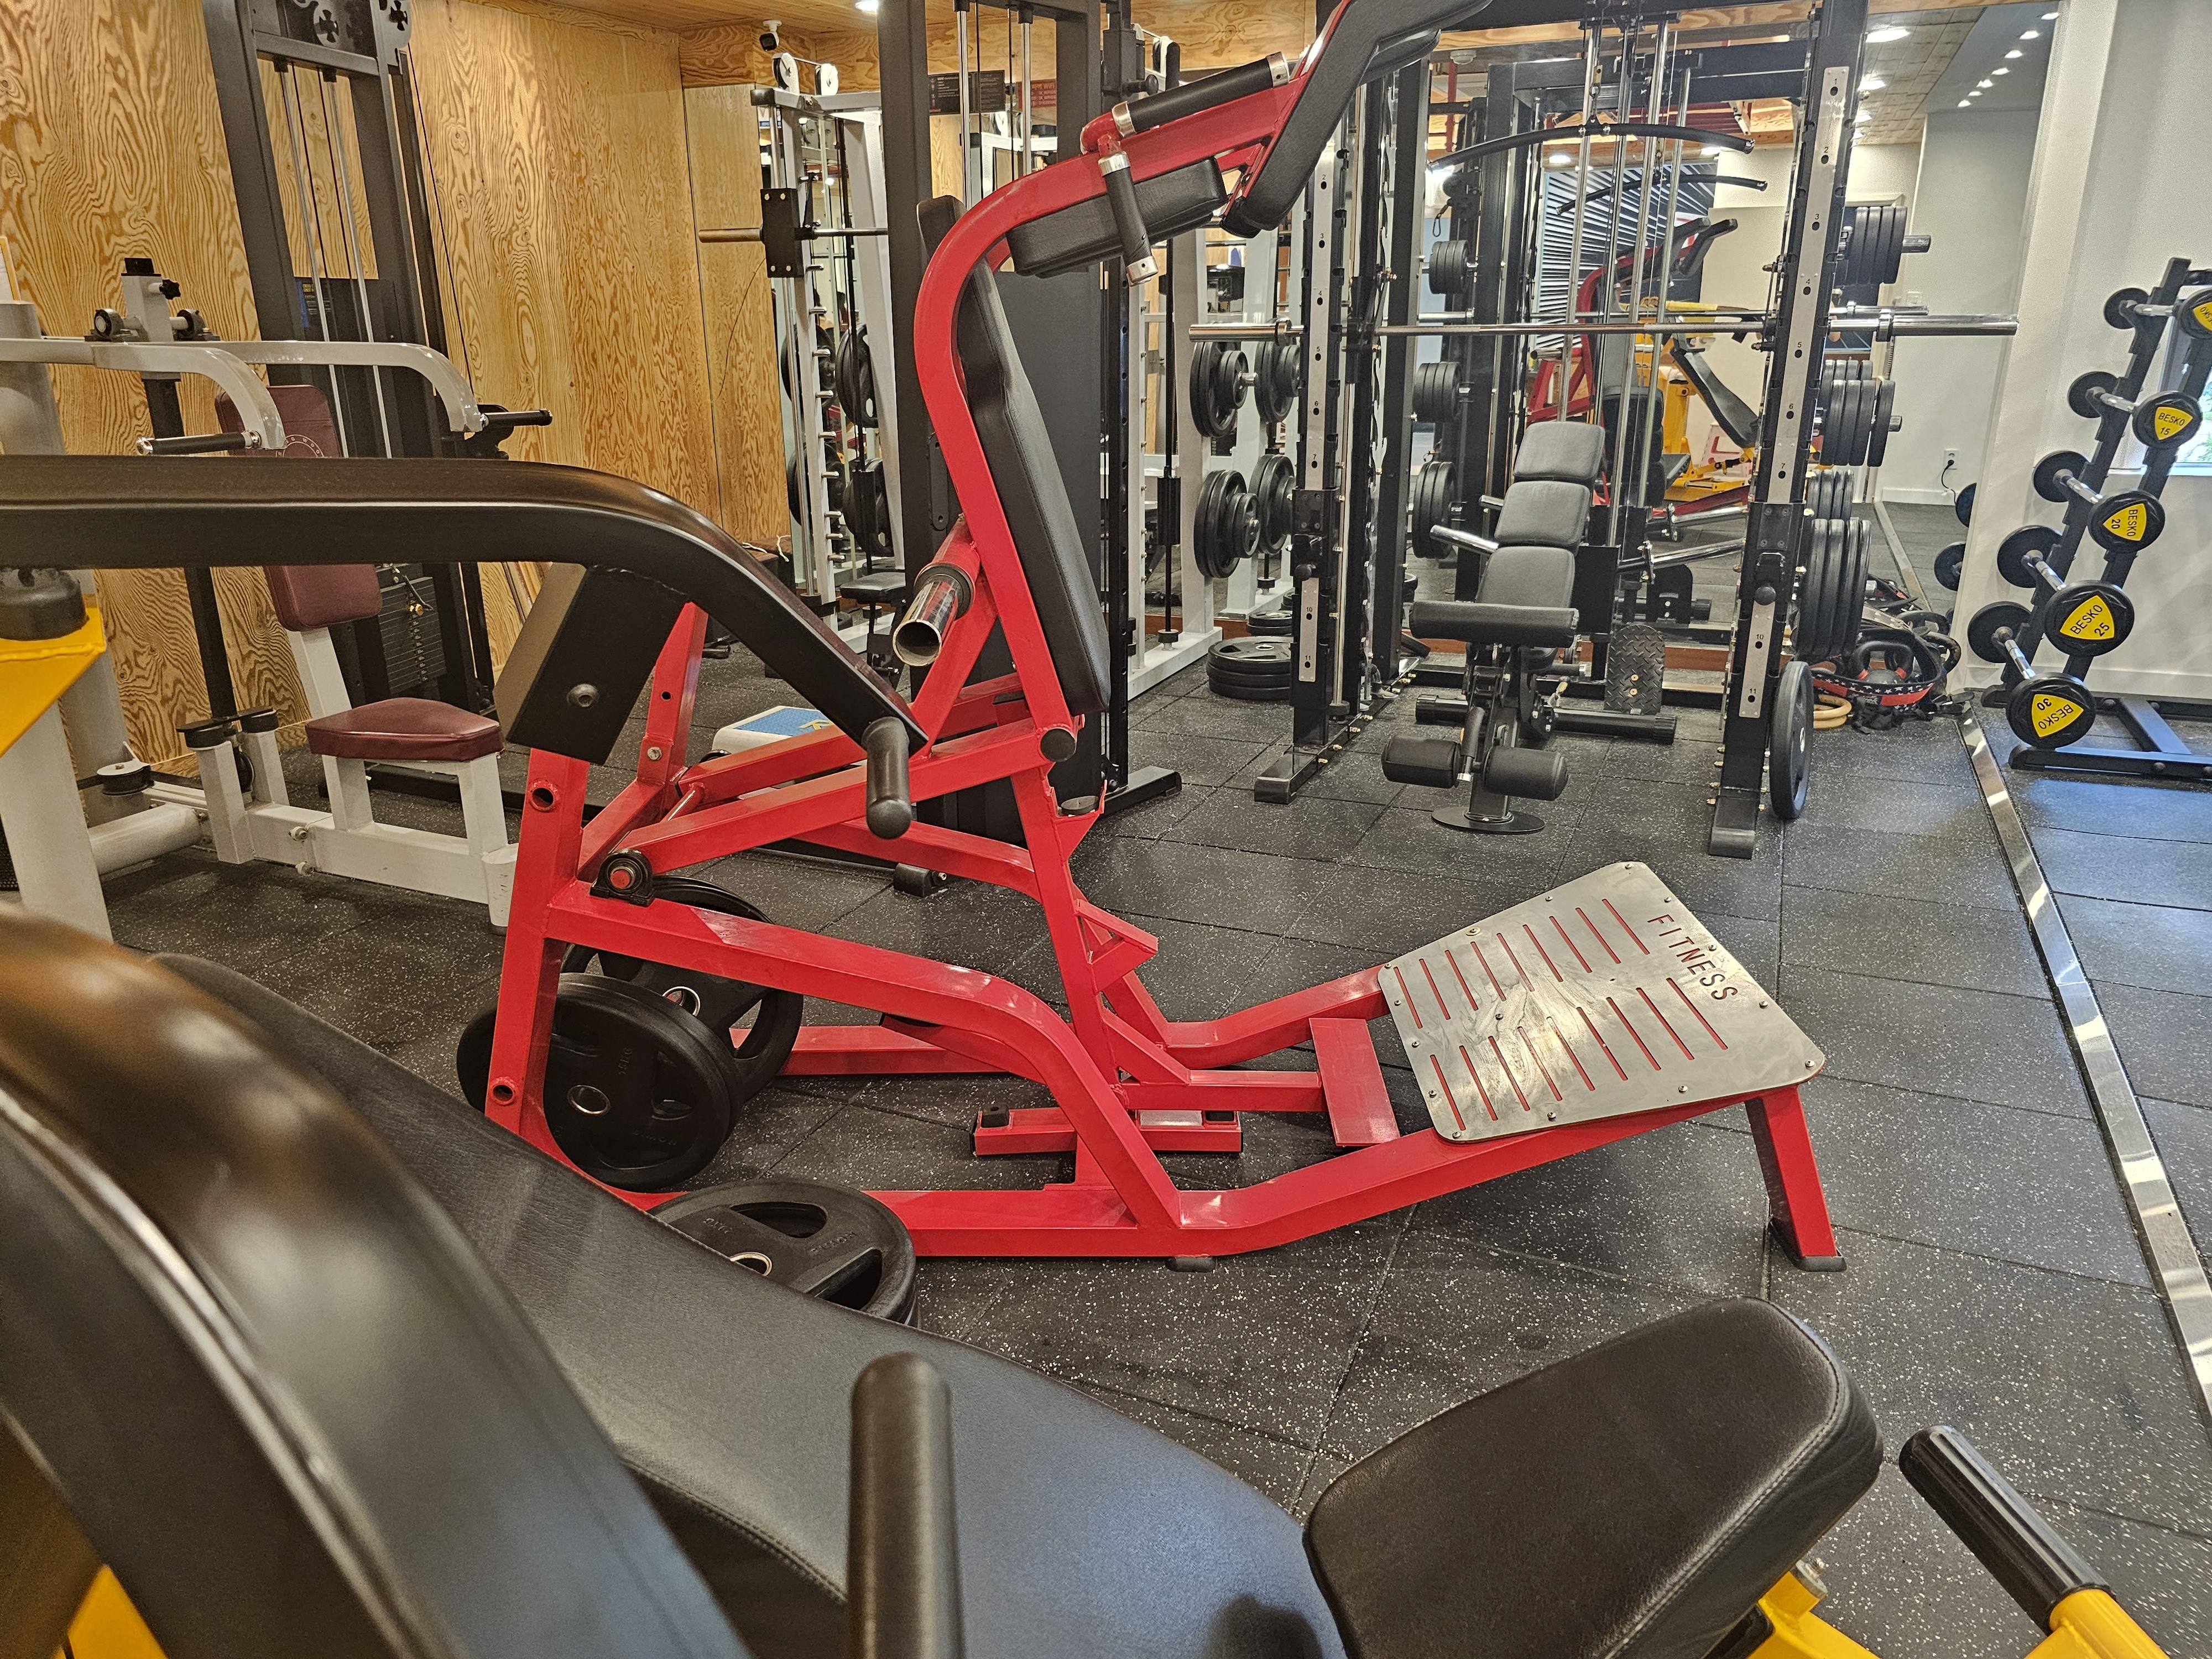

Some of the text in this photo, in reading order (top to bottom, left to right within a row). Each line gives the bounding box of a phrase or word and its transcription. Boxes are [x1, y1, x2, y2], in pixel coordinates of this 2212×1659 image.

[2200, 307, 2212, 325] SKO
[2158, 413, 2185, 426] BESKO
[2160, 427, 2171, 435] 15
[2111, 519, 2120, 529] 20
[2127, 509, 2138, 536] BESKO
[2070, 604, 2103, 634] BESKO
[2094, 622, 2110, 637] 25
[2037, 698, 2052, 711] 30
[2038, 704, 2074, 729] BESKO
[1647, 914, 1738, 1000] FITNESS
